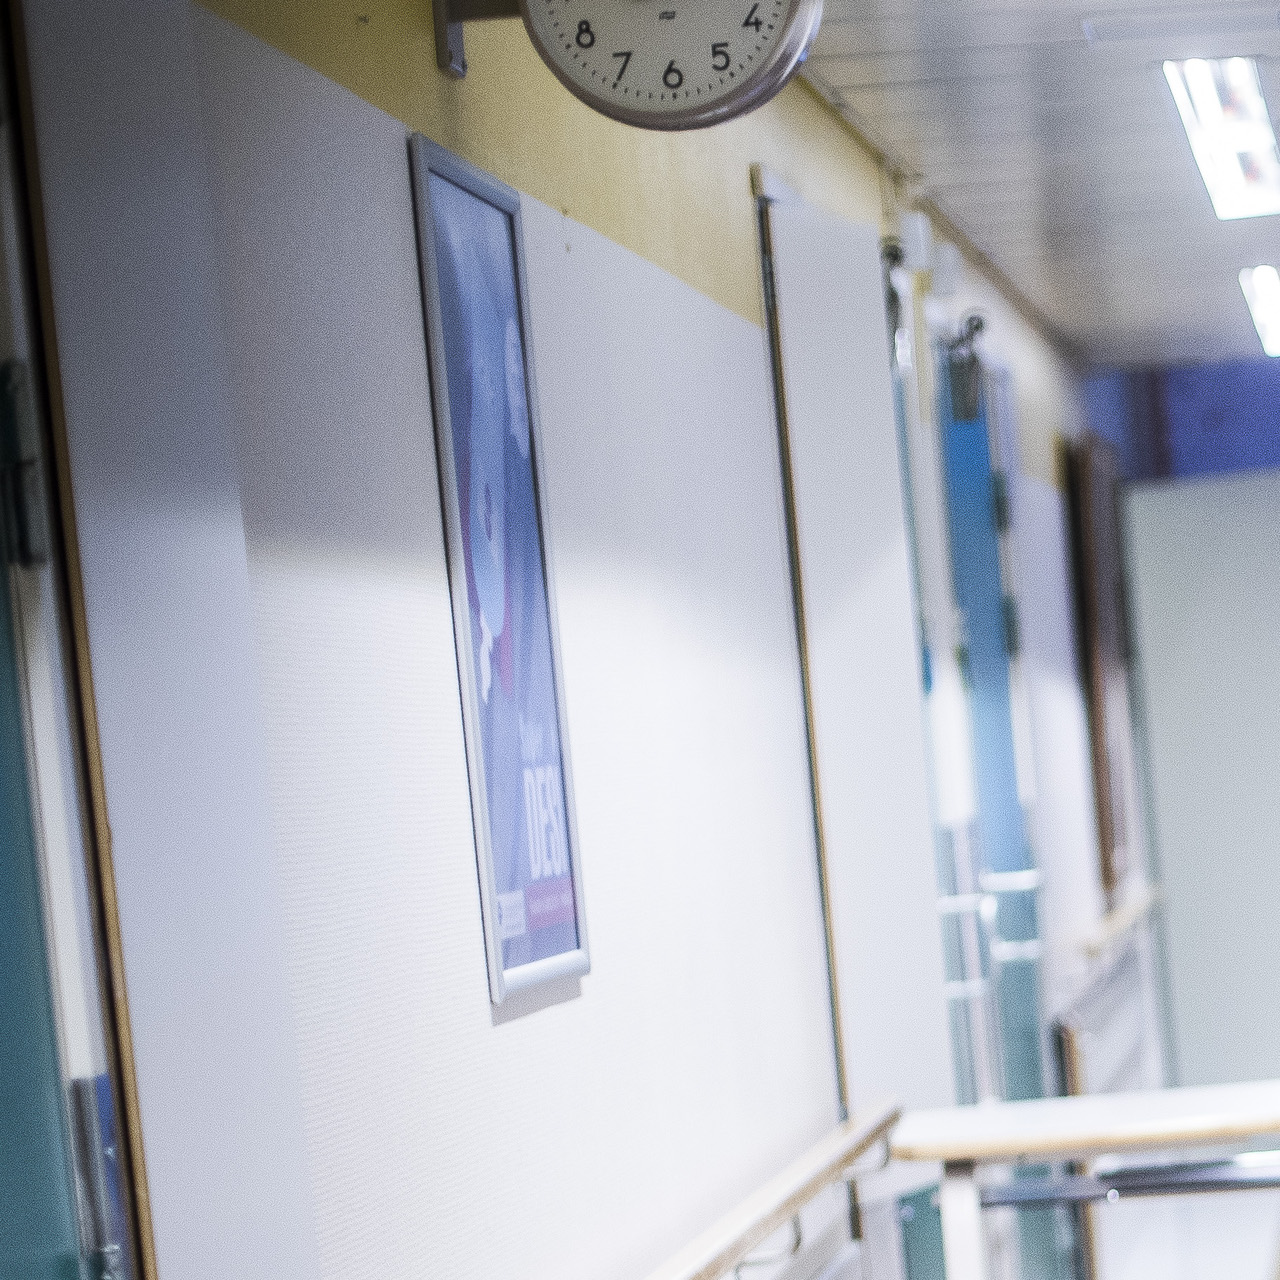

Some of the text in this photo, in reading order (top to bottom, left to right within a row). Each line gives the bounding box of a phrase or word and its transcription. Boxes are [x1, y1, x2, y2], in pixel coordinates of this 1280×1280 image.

[741, 2, 763, 33] 4
[575, 19, 596, 49] 8
[612, 50, 634, 82] 7
[710, 41, 731, 72] 5
[661, 59, 684, 90] 6
